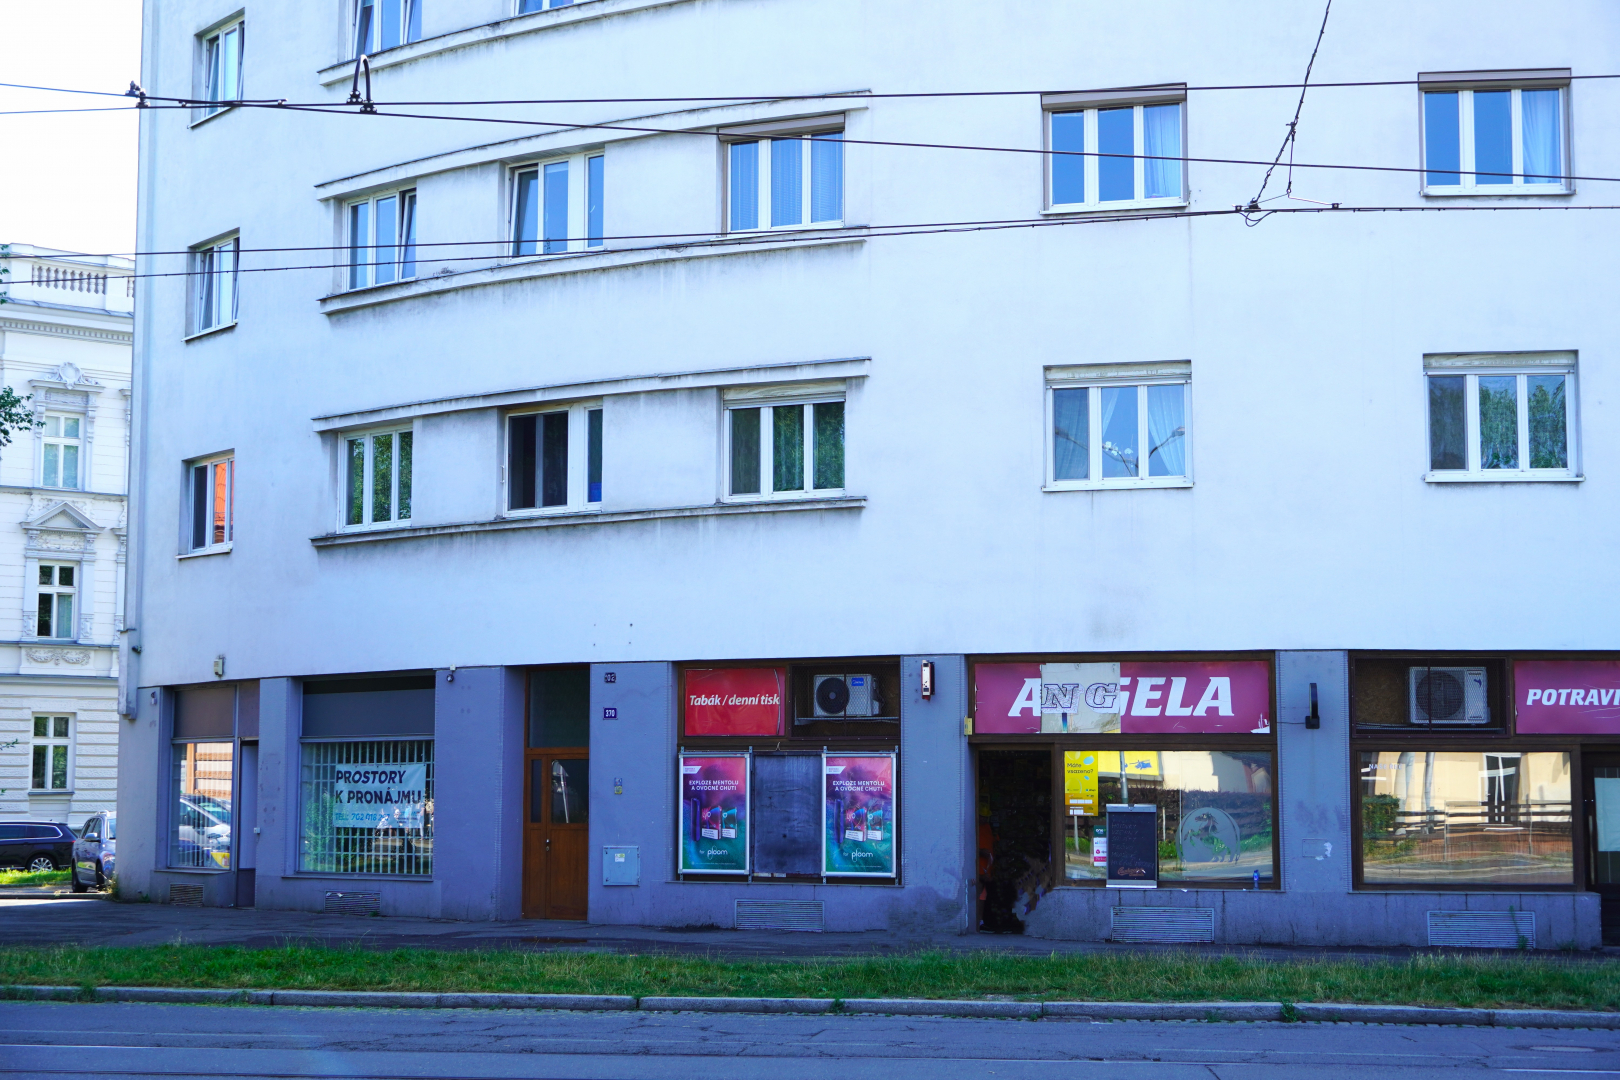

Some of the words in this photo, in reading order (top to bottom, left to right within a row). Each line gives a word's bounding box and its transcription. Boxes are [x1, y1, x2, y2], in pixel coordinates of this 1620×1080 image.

[690, 694, 721, 706] Tabák
[728, 694, 760, 705] denní
[760, 694, 780, 705] tisk
[336, 770, 406, 783] PROSTORY
[336, 790, 343, 803] K
[347, 787, 421, 804] PRONÁJMU
[706, 845, 728, 860] ploom
[851, 848, 874, 862] ploom
